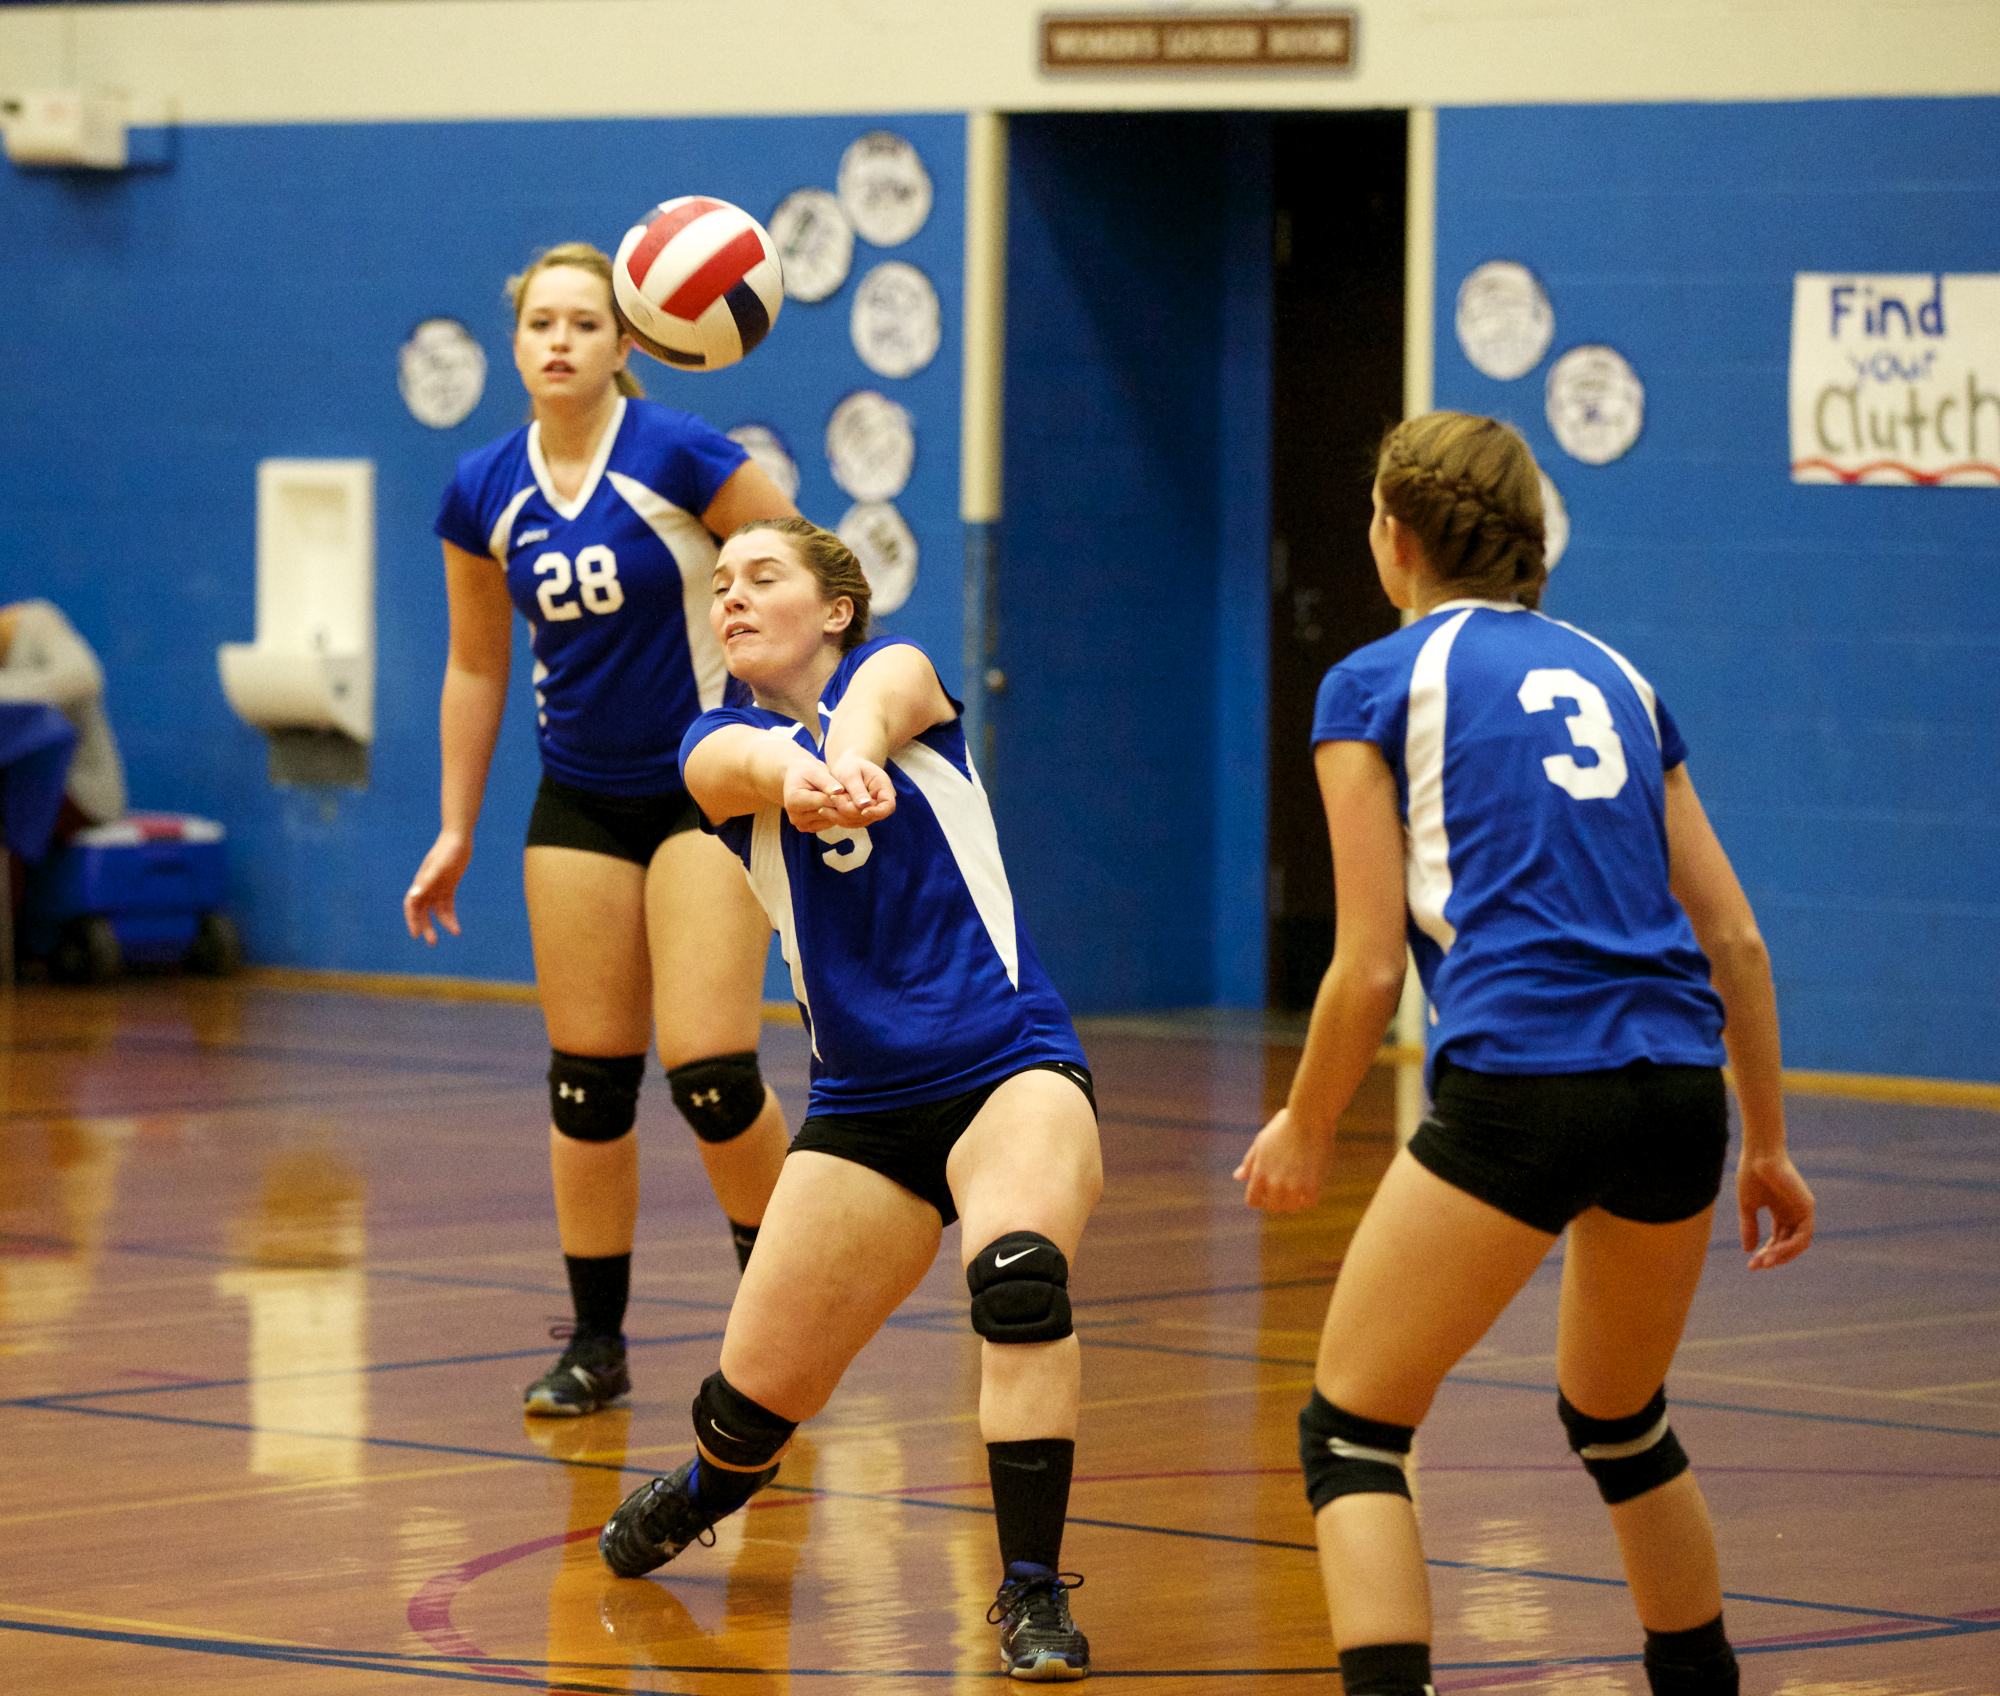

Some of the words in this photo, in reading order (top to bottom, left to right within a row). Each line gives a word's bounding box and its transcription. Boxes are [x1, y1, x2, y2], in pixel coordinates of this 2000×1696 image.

[1829, 272, 1945, 338] Find
[1847, 349, 1937, 392] your
[1814, 370, 2000, 457] Clutch
[533, 544, 625, 622] 28
[1517, 668, 1628, 800] 3
